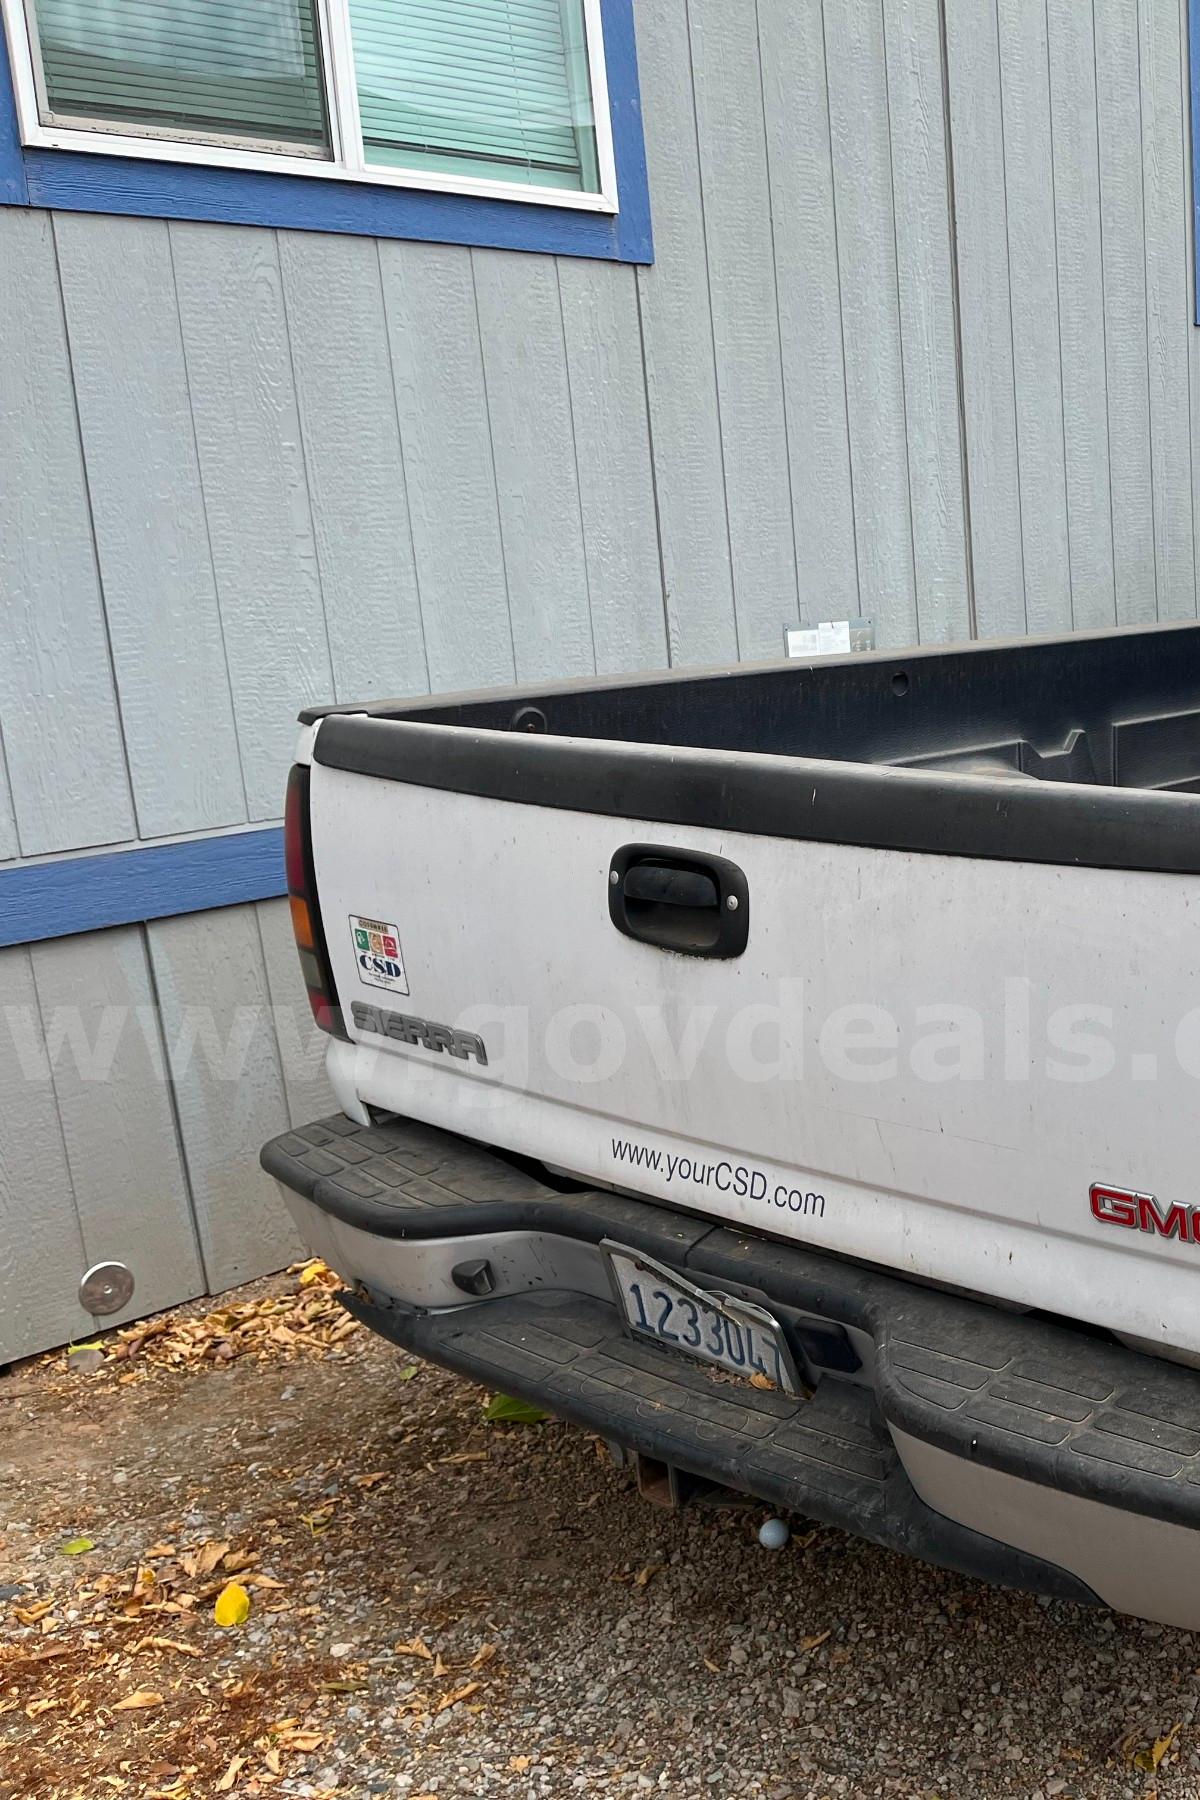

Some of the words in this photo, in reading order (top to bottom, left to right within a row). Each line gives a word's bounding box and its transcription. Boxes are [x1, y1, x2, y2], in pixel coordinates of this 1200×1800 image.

[359, 954, 402, 978] CSD
[351, 1000, 488, 1066] SIERRA
[611, 1138, 826, 1218] www.yourCSD.com
